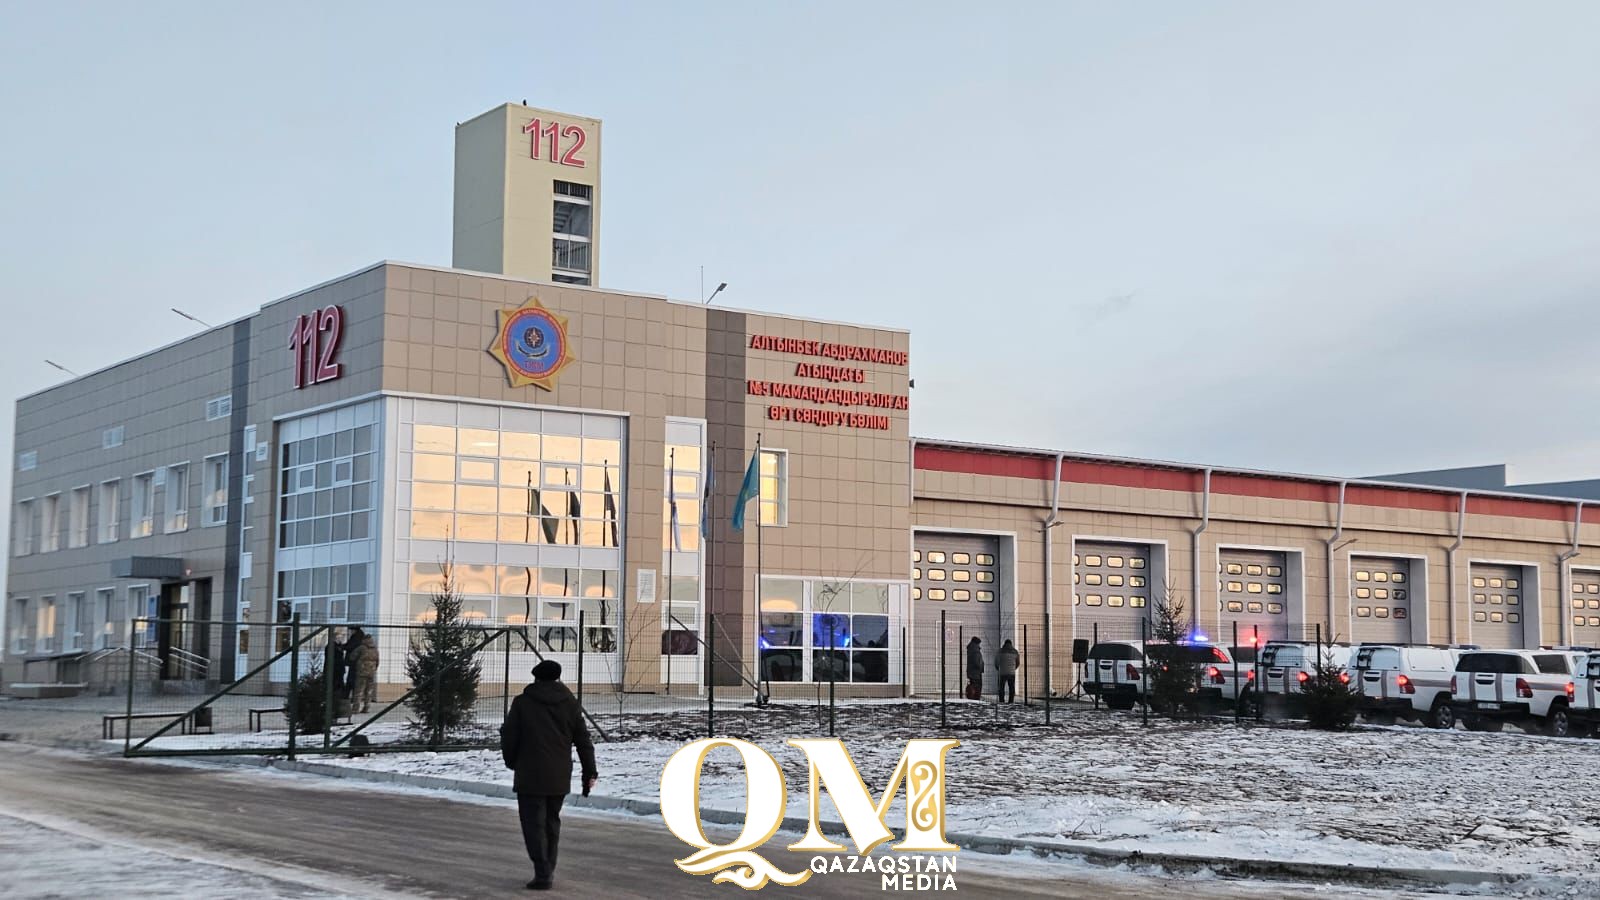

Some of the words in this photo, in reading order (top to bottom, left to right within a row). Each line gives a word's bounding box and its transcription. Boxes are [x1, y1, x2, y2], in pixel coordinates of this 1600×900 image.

[522, 117, 587, 168] 112
[288, 304, 344, 390] 112
[751, 335, 819, 356] АЛТЫНБЕК
[822, 343, 909, 366] АБДРАХМАНОВ
[769, 405, 794, 421] ӨРТ
